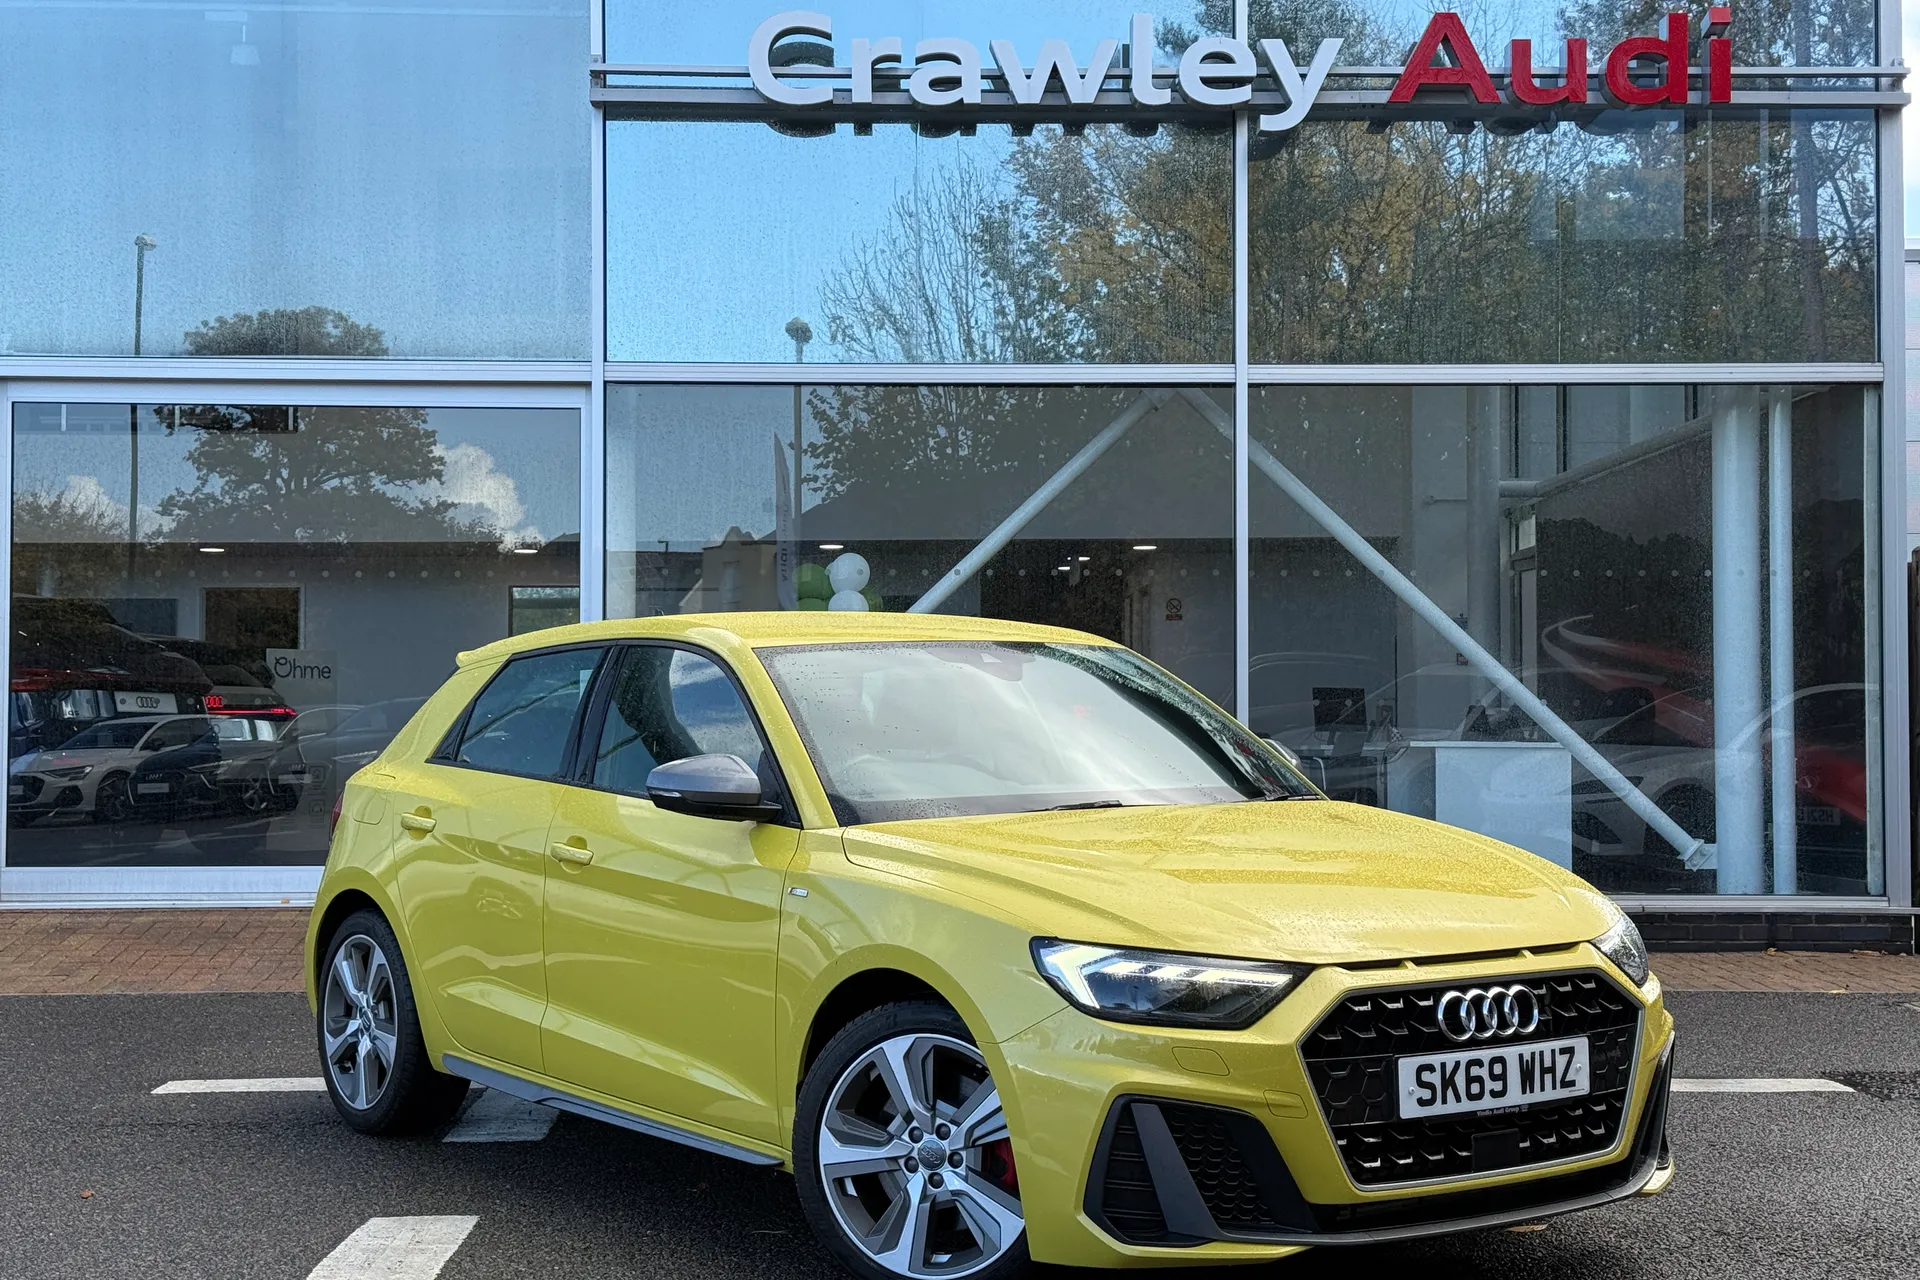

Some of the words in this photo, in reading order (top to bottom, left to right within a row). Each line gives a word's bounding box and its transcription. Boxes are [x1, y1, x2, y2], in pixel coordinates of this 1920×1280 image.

[748, 10, 1345, 132] Crawley
[1387, 7, 1732, 105] Audi
[274, 656, 332, 679] Ohme
[1415, 1055, 1508, 1108] SK69
[1518, 1046, 1577, 1095] WHZ
